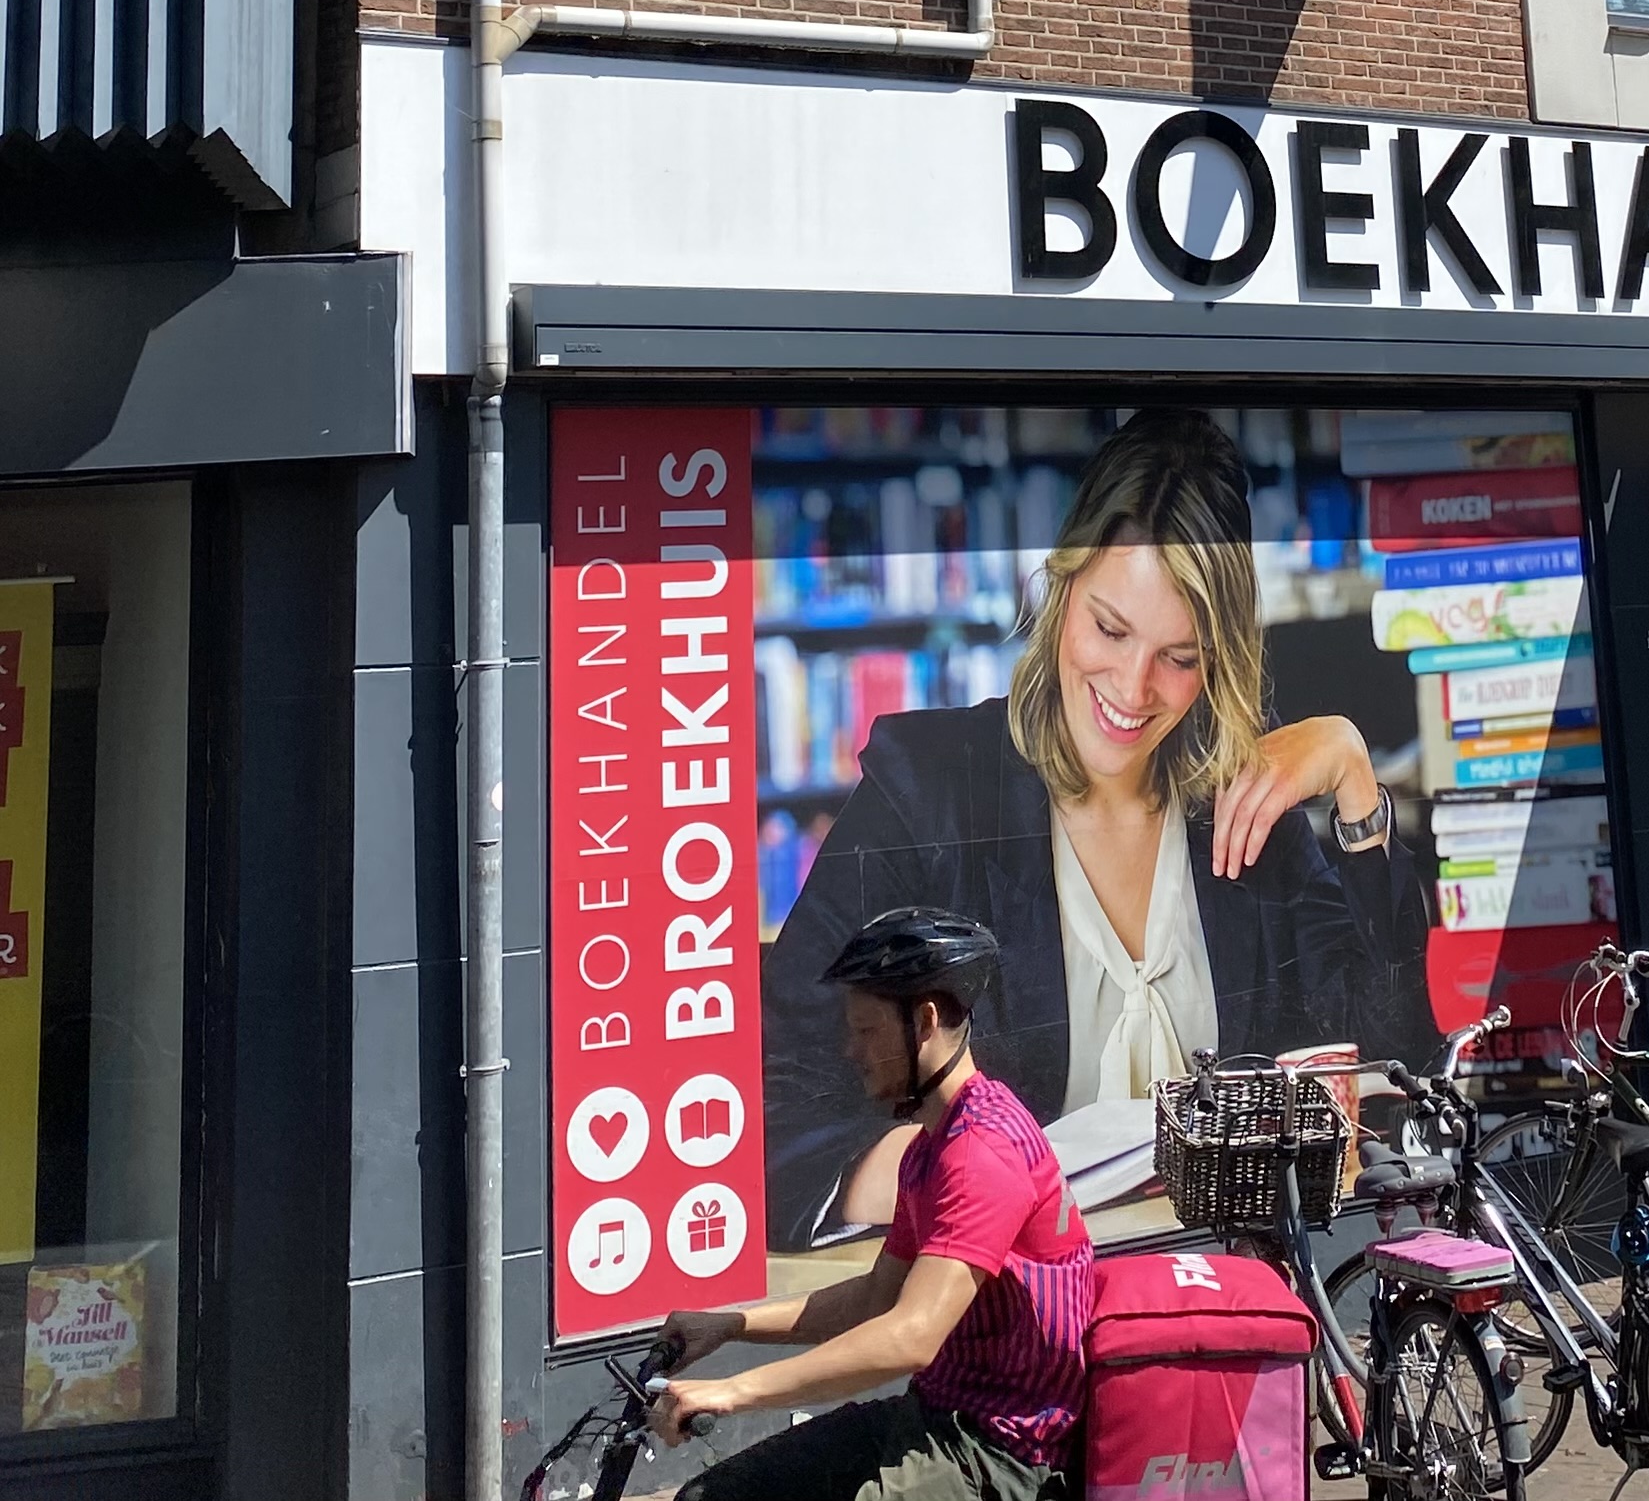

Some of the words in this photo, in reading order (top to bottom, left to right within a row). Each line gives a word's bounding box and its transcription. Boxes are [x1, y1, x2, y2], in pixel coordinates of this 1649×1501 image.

[1421, 495, 1492, 525] KOKEN
[577, 455, 631, 1051] BOEKHANDEL
[658, 448, 734, 1040] BROEKHUIS
[72, 1302, 112, 1327] Jill
